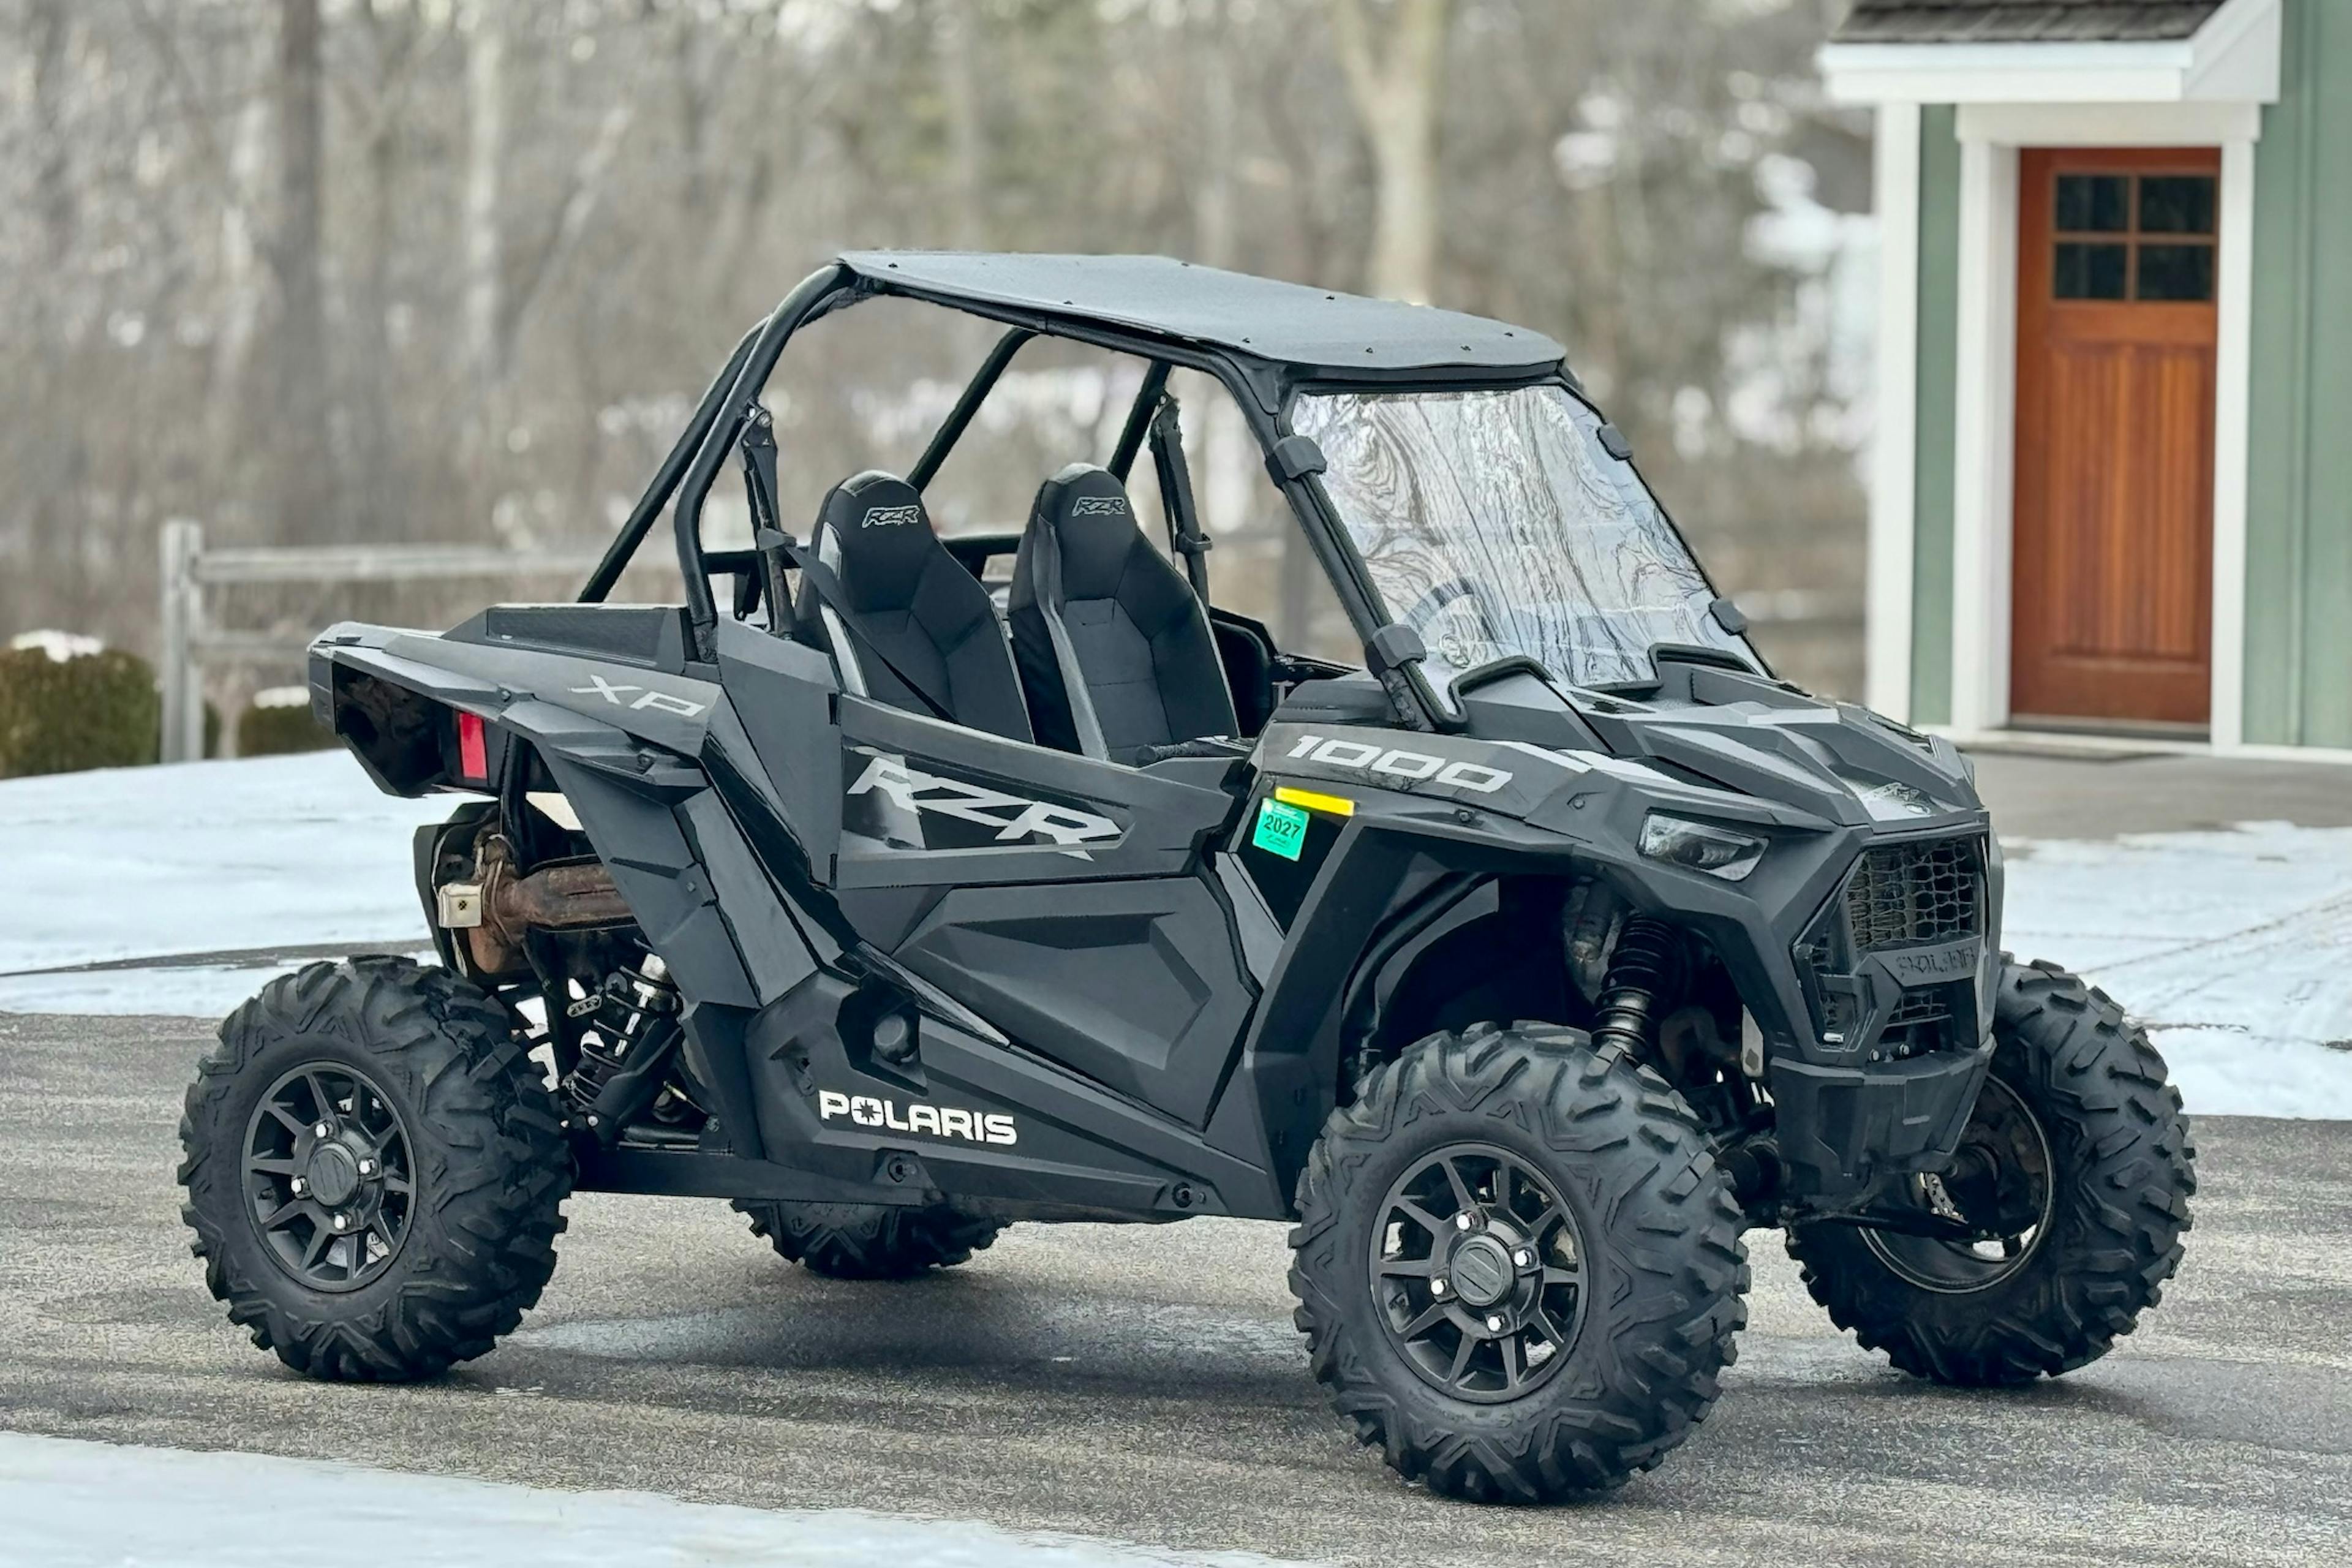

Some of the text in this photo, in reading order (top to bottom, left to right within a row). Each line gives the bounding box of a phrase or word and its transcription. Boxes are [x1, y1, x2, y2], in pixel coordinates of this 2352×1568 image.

[569, 674, 706, 717] XP
[1286, 735, 1513, 793] 1000
[846, 756, 1123, 862] RZR
[1264, 814, 1302, 840] 2027
[819, 1090, 1017, 1145] POLARIS
